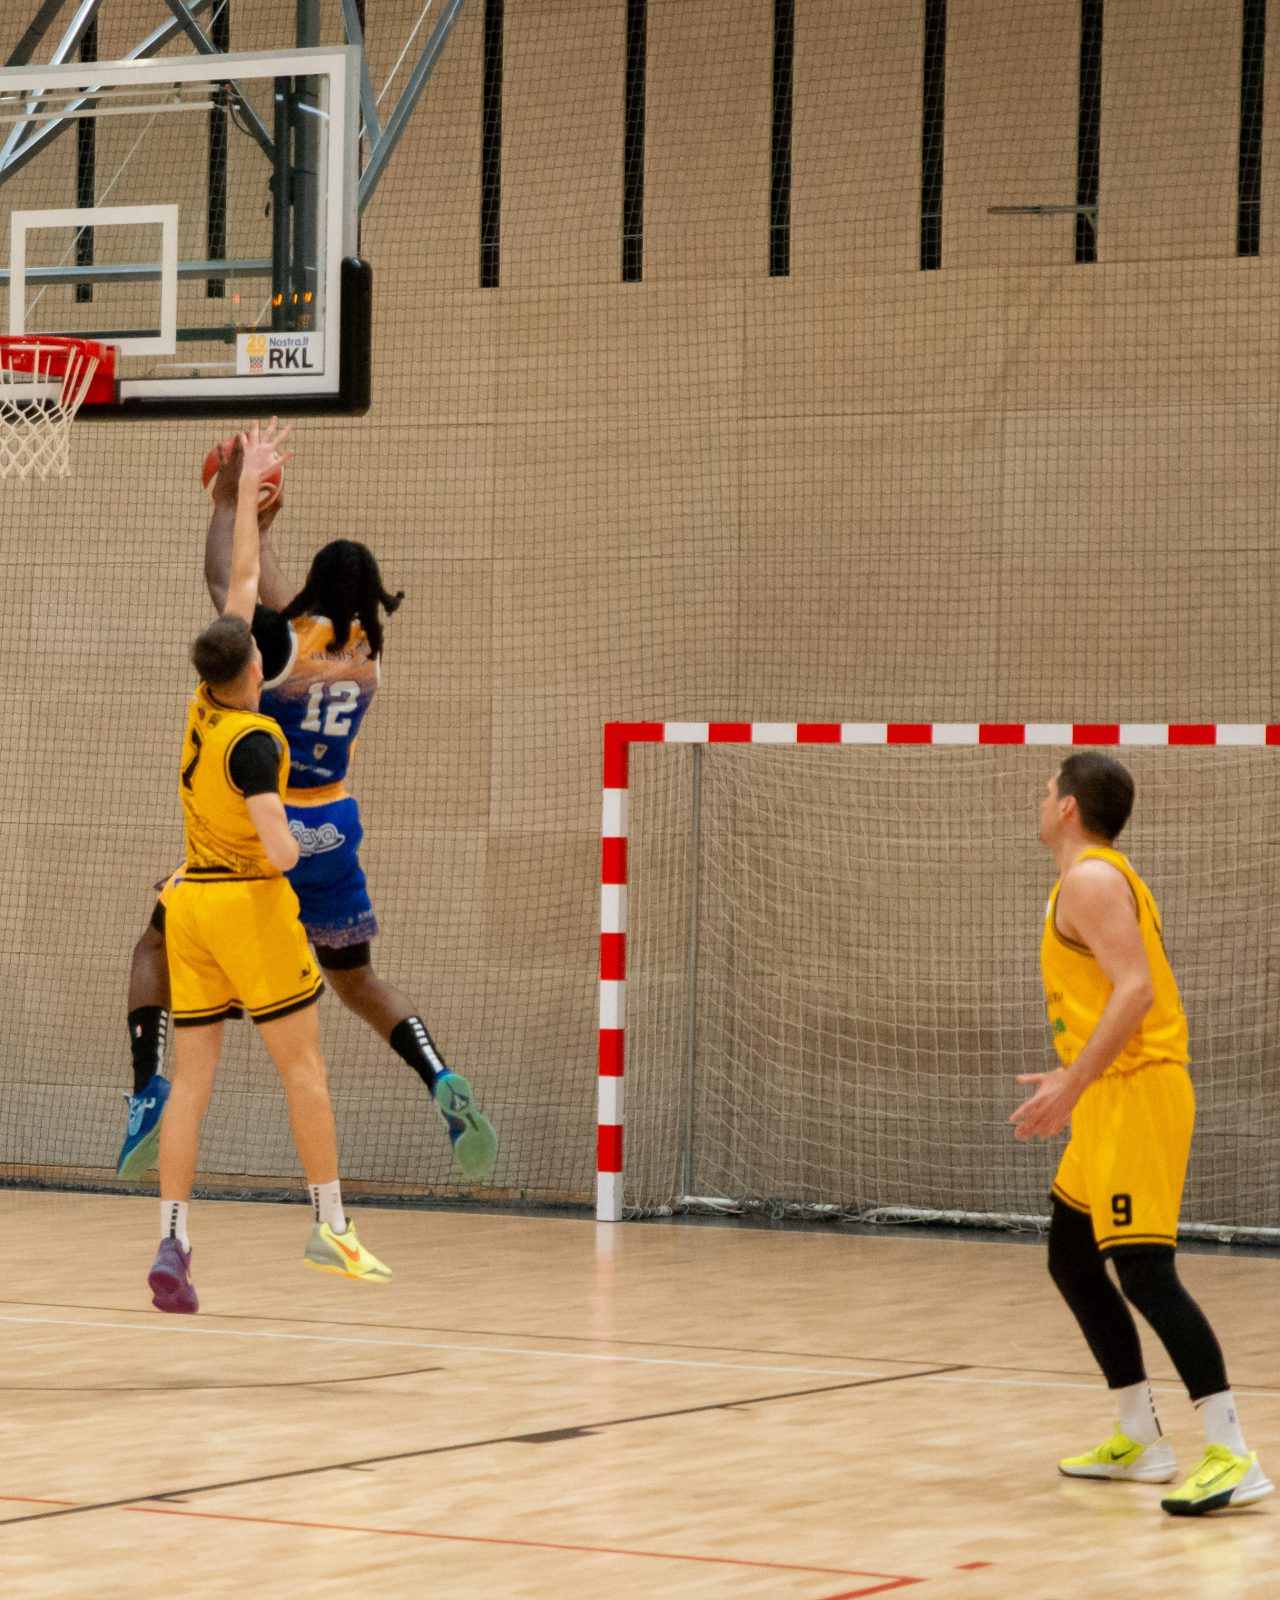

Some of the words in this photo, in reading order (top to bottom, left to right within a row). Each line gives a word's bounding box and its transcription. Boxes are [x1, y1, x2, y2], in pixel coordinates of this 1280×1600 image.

[269, 336, 309, 347] Nostra.lt
[269, 347, 313, 369] RKL
[300, 680, 360, 735] 12
[1112, 1193, 1132, 1227] 9
